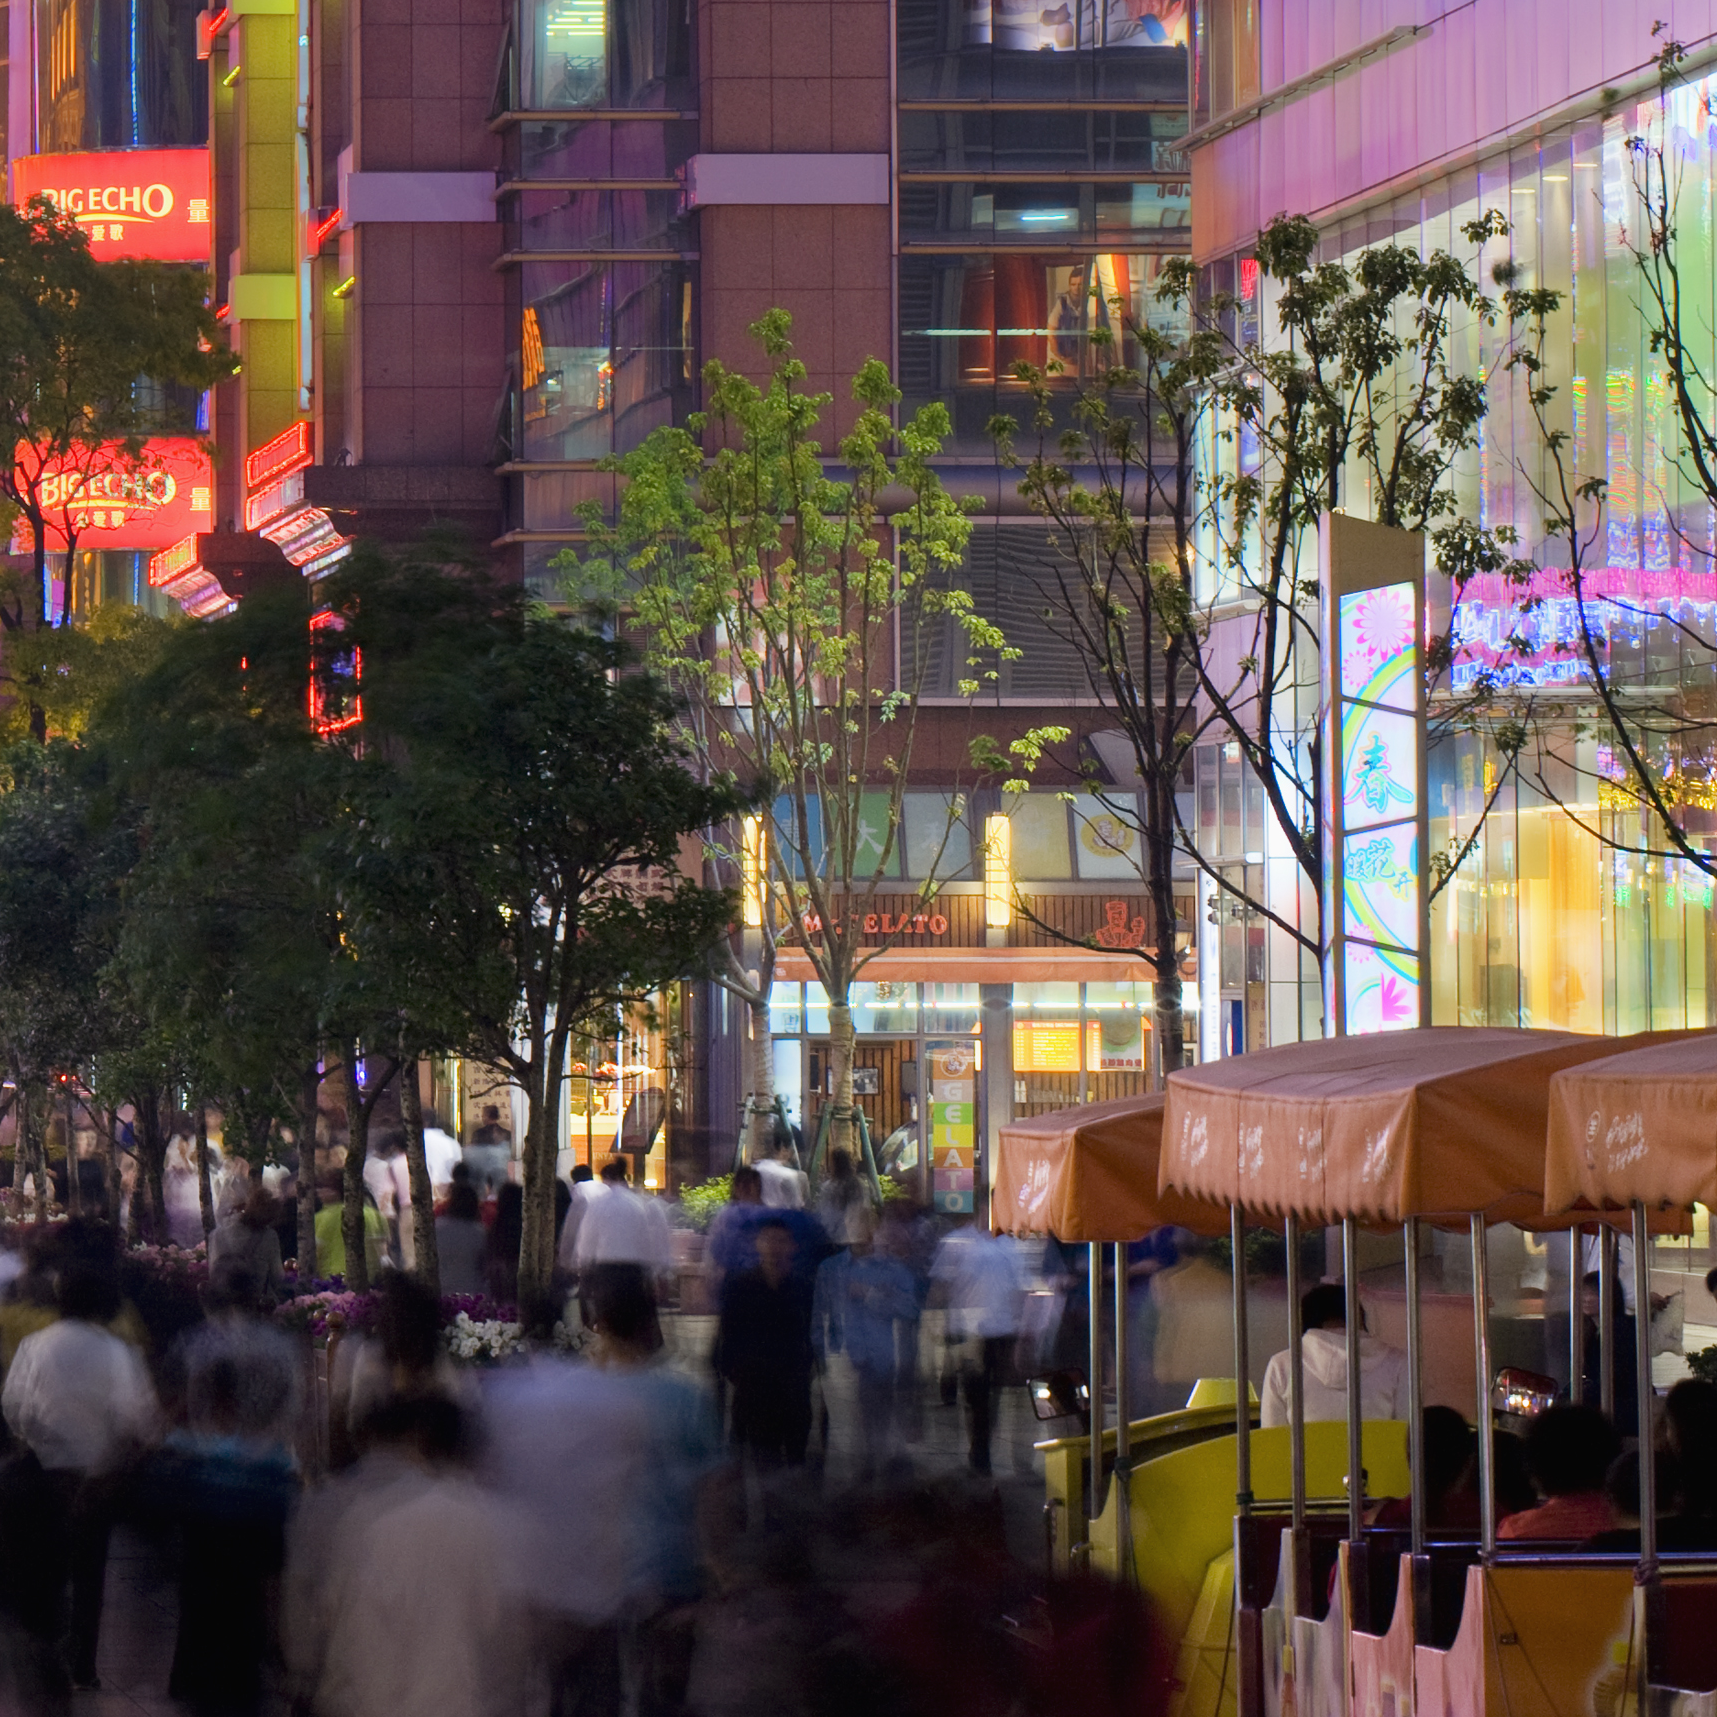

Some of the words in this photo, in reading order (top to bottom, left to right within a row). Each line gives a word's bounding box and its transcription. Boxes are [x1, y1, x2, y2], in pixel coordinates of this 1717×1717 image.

[87, 183, 174, 219] ECHO
[40, 472, 84, 508] BIG
[1344, 731, 1414, 814] 春
[943, 1082, 964, 1211] GELATO
